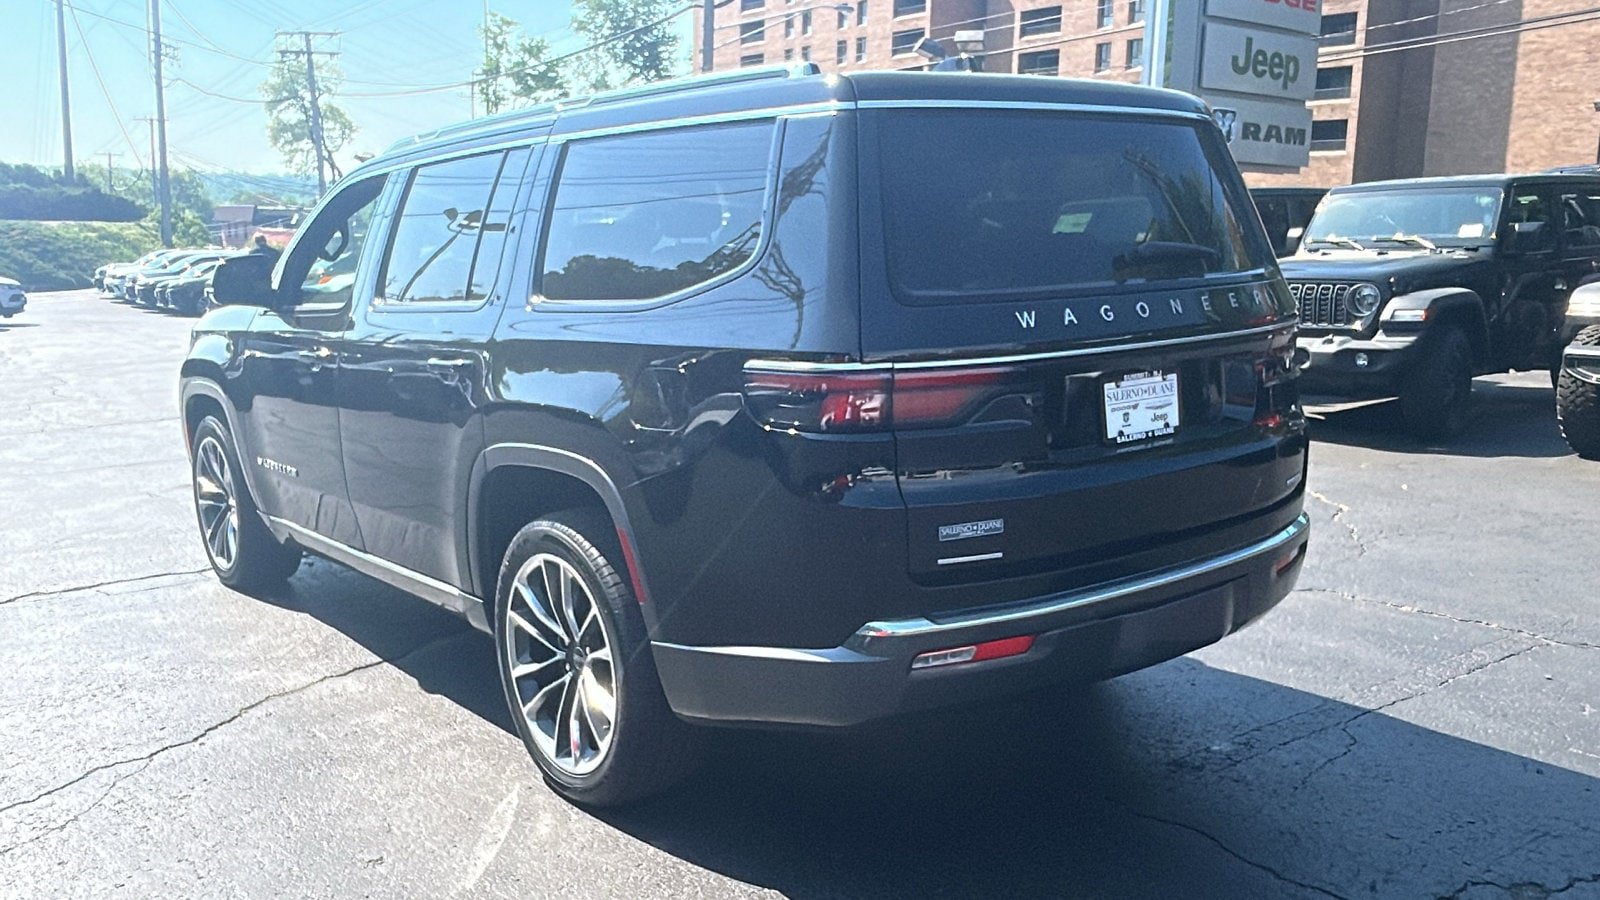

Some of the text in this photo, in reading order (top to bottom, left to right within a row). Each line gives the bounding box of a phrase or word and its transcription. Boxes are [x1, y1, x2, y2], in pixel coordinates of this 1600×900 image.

[1231, 36, 1300, 90] Jeep
[1241, 121, 1306, 146] RAM
[1015, 289, 1265, 328] WAGONEER
[1106, 387, 1143, 401] SALERNO
[1151, 412, 1168, 422] Jeep
